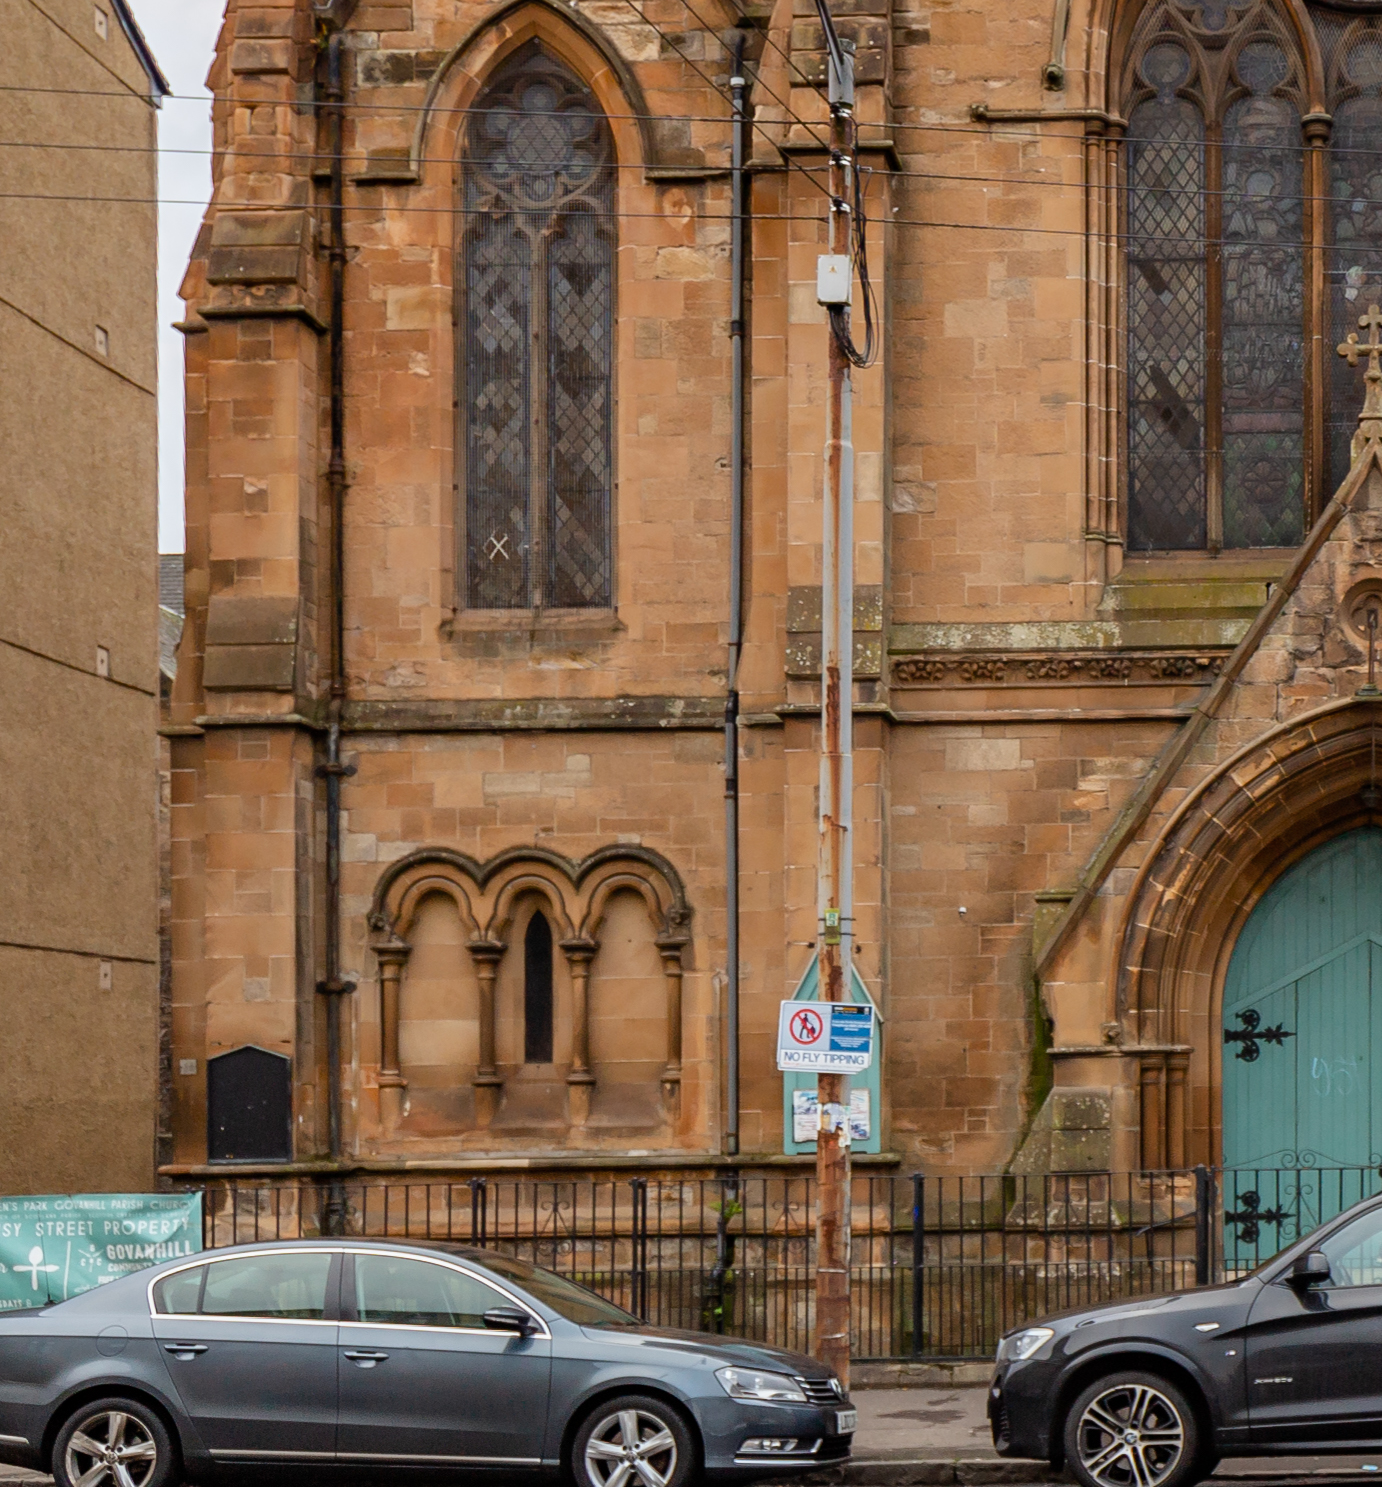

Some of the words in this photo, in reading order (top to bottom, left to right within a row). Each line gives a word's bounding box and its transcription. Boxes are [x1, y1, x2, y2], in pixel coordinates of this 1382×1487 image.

[784, 1051, 800, 1062] NO
[802, 1052, 820, 1063] FLY
[822, 1054, 865, 1066] TIPPING
[23, 1200, 48, 1211] PARK
[111, 1199, 144, 1210] PARISH
[36, 1221, 93, 1237] STREET
[104, 1217, 189, 1236] PROPERTY
[106, 1240, 194, 1260] GOVANHILL
